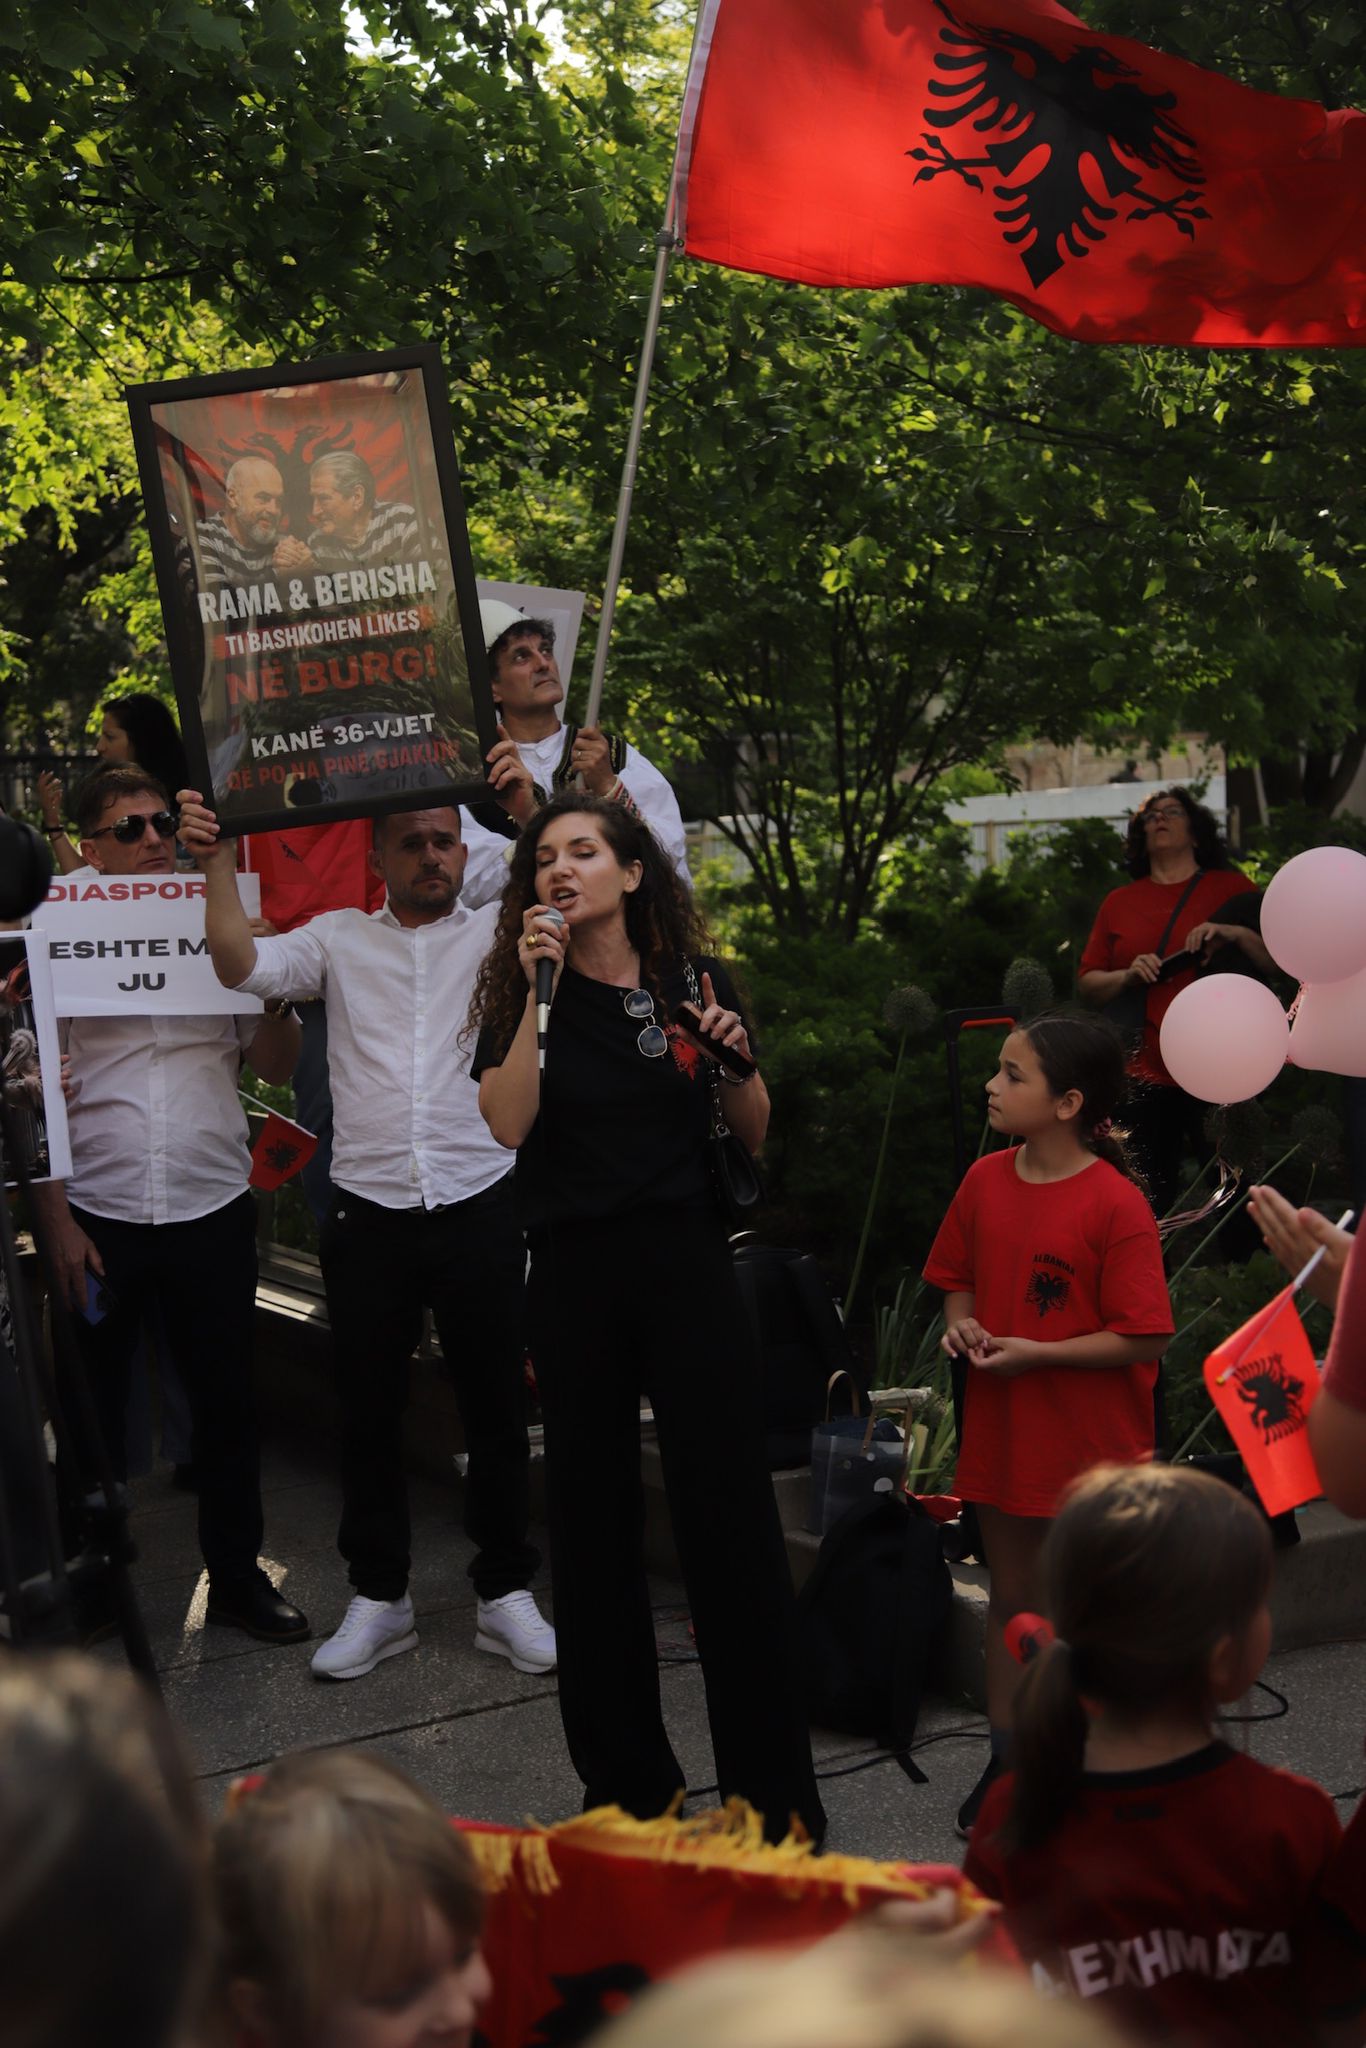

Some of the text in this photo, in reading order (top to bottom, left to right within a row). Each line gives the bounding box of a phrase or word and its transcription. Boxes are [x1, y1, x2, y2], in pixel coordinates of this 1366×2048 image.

[198, 561, 437, 624] RAMA & BERISHA
[225, 610, 421, 656] TI BASHKOHEN LIKES
[226, 643, 438, 705] NË BURG!
[251, 713, 436, 758] KANË 36-VJET
[259, 764, 286, 786] PO
[44, 882, 207, 902] DIASPOR
[49, 938, 211, 959] ESHTE M
[117, 973, 166, 992] JU
